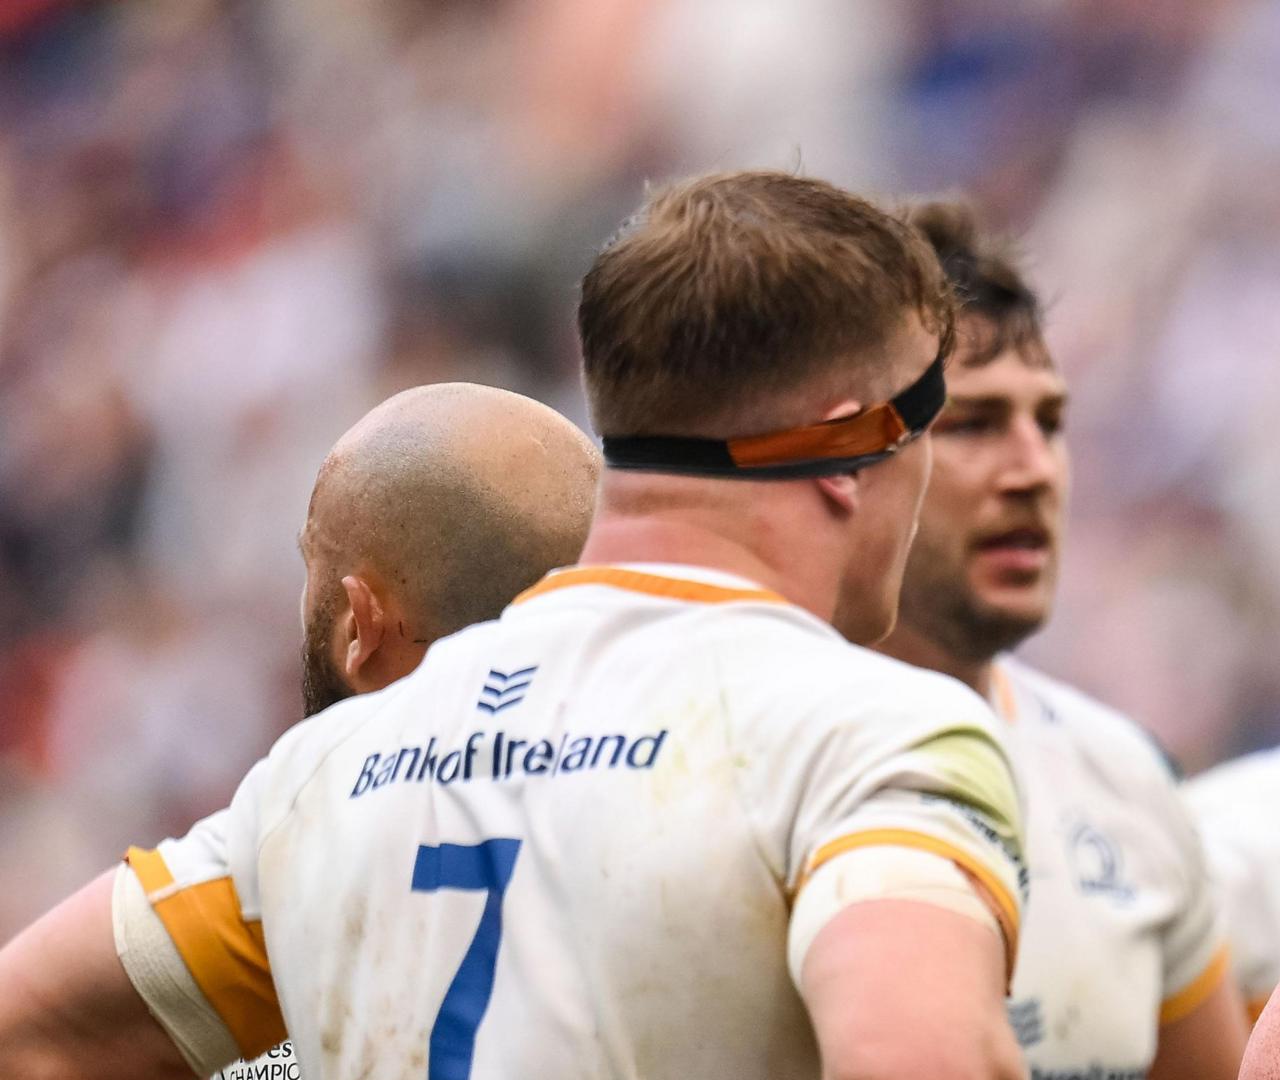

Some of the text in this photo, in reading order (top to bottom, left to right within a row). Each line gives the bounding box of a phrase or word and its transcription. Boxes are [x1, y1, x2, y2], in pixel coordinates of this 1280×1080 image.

[349, 729, 669, 800] Bank of Ireland
